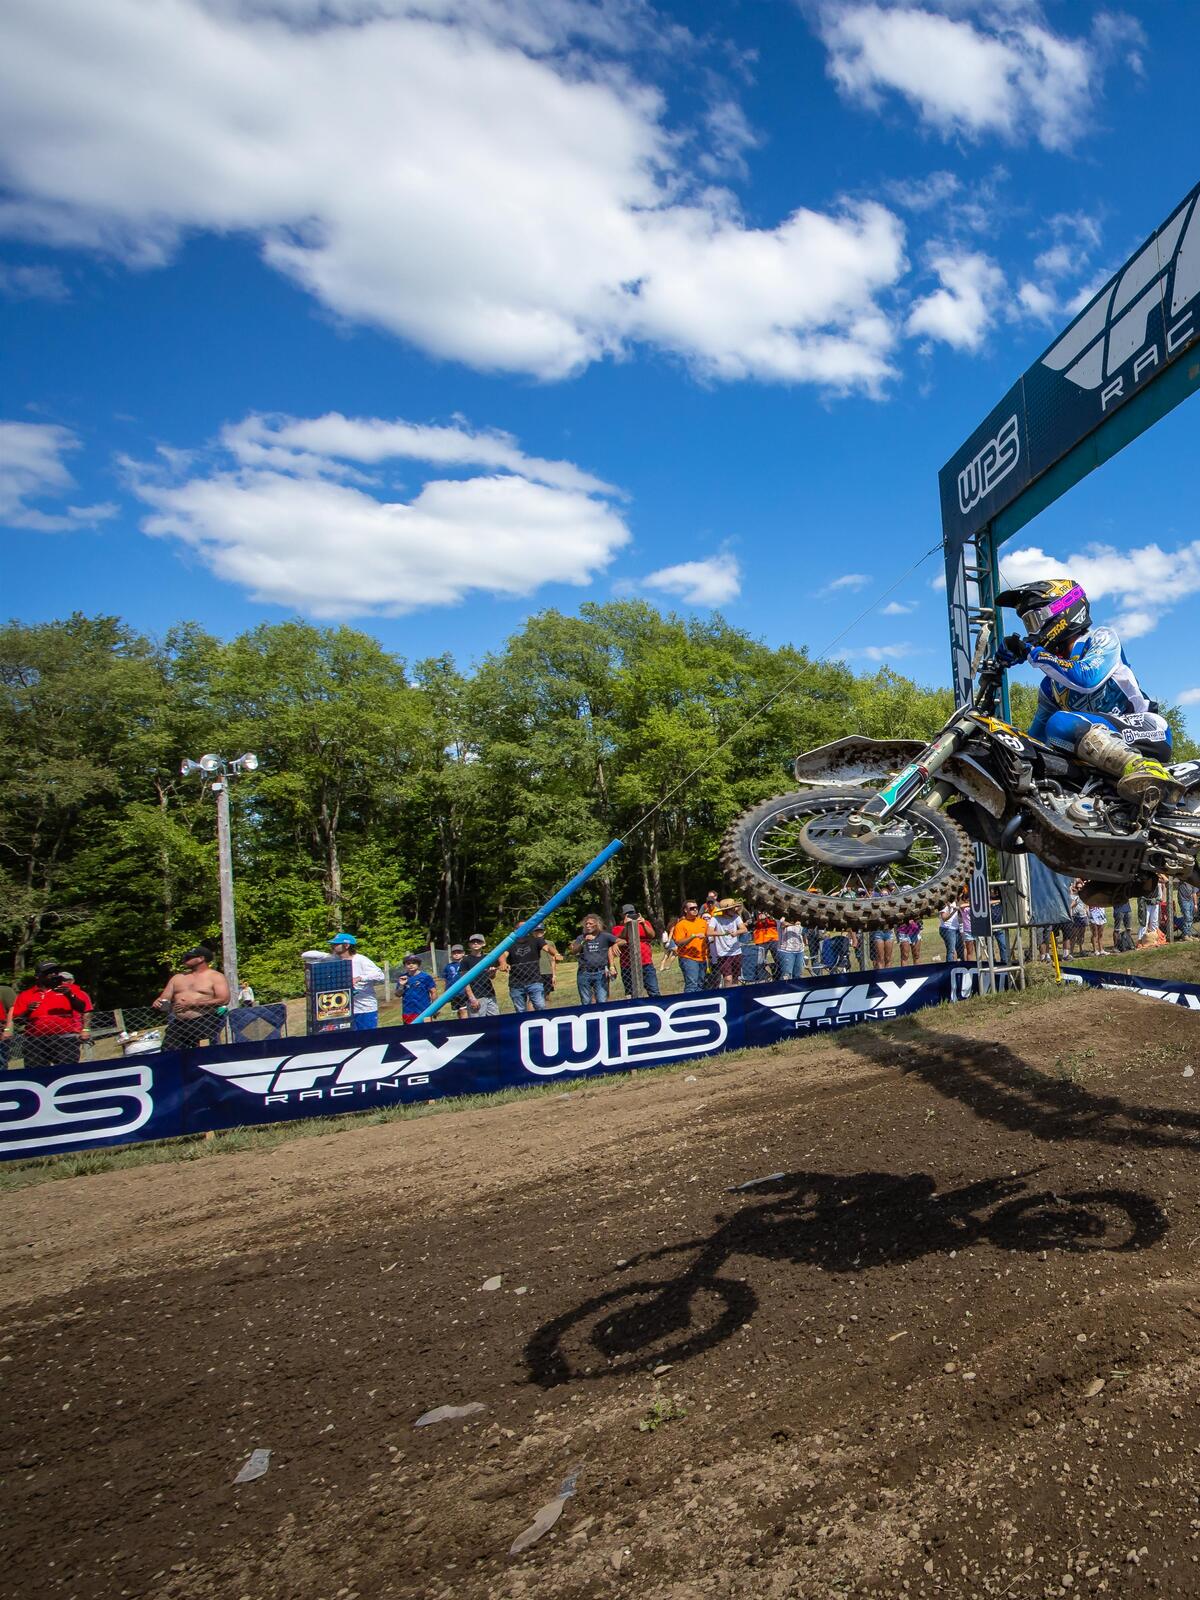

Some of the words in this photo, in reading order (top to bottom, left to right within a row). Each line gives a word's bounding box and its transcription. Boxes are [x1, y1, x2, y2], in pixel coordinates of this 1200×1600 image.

[958, 413, 1020, 514] WPS
[753, 976, 930, 1019] FLY
[795, 1008, 898, 1030] RACING
[520, 997, 728, 1076] WPS
[199, 1033, 485, 1094] FLY
[265, 1074, 430, 1106] RACING
